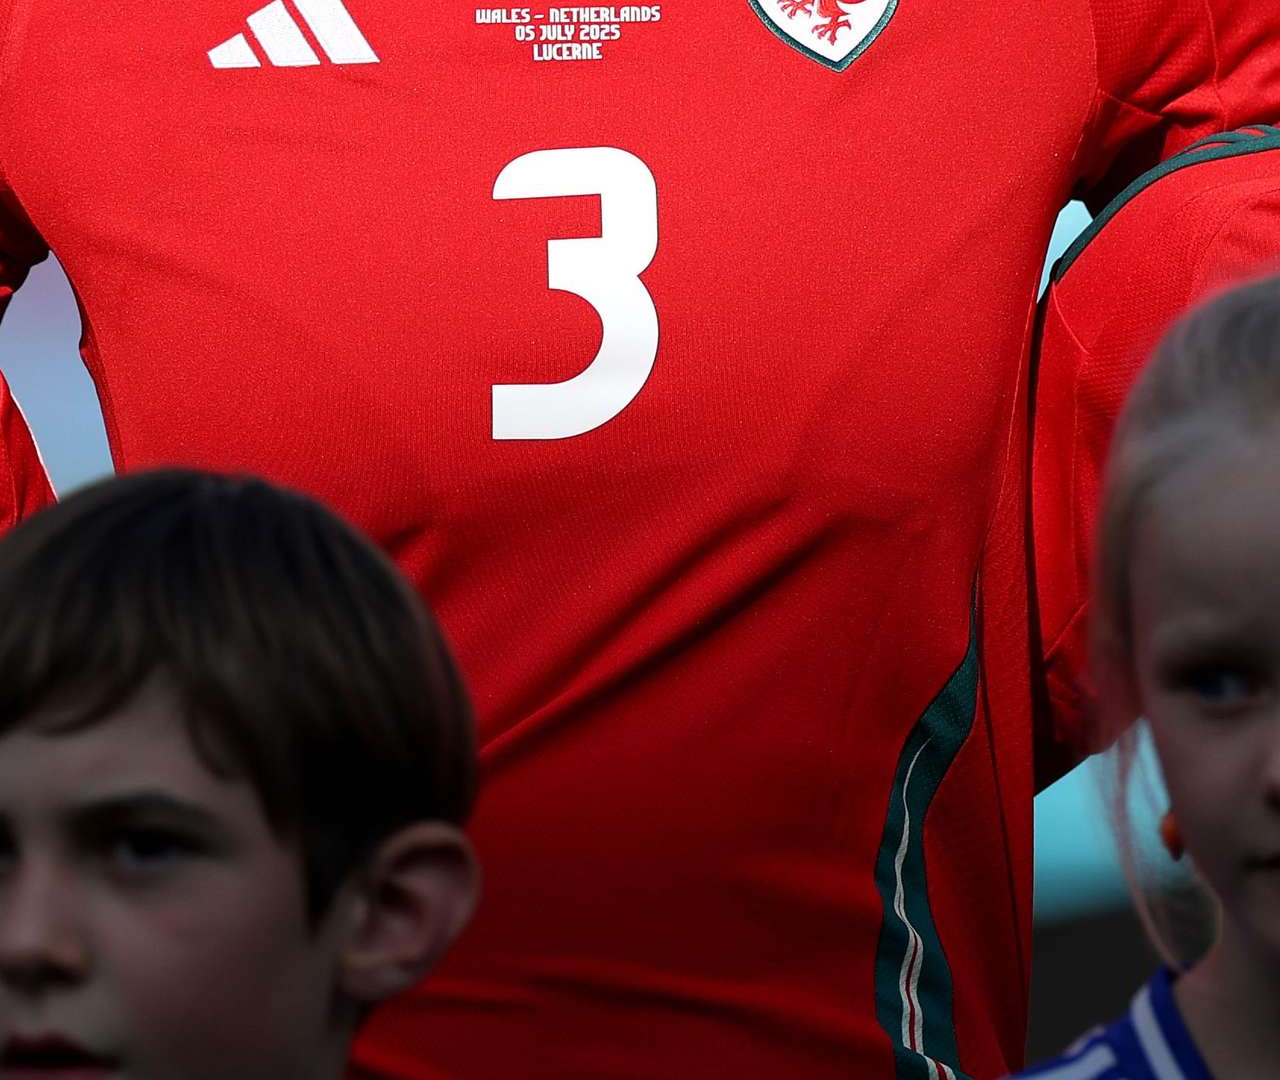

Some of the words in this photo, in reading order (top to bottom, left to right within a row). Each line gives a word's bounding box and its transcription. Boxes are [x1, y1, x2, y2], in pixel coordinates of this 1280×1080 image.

[475, 8, 531, 24] WALES
[549, 5, 661, 23] NETHERLANDS
[514, 24, 536, 41] 05
[539, 24, 575, 41] JULY
[579, 24, 621, 41] 2025
[532, 42, 603, 61] LUCERNE
[491, 146, 659, 440] 3
